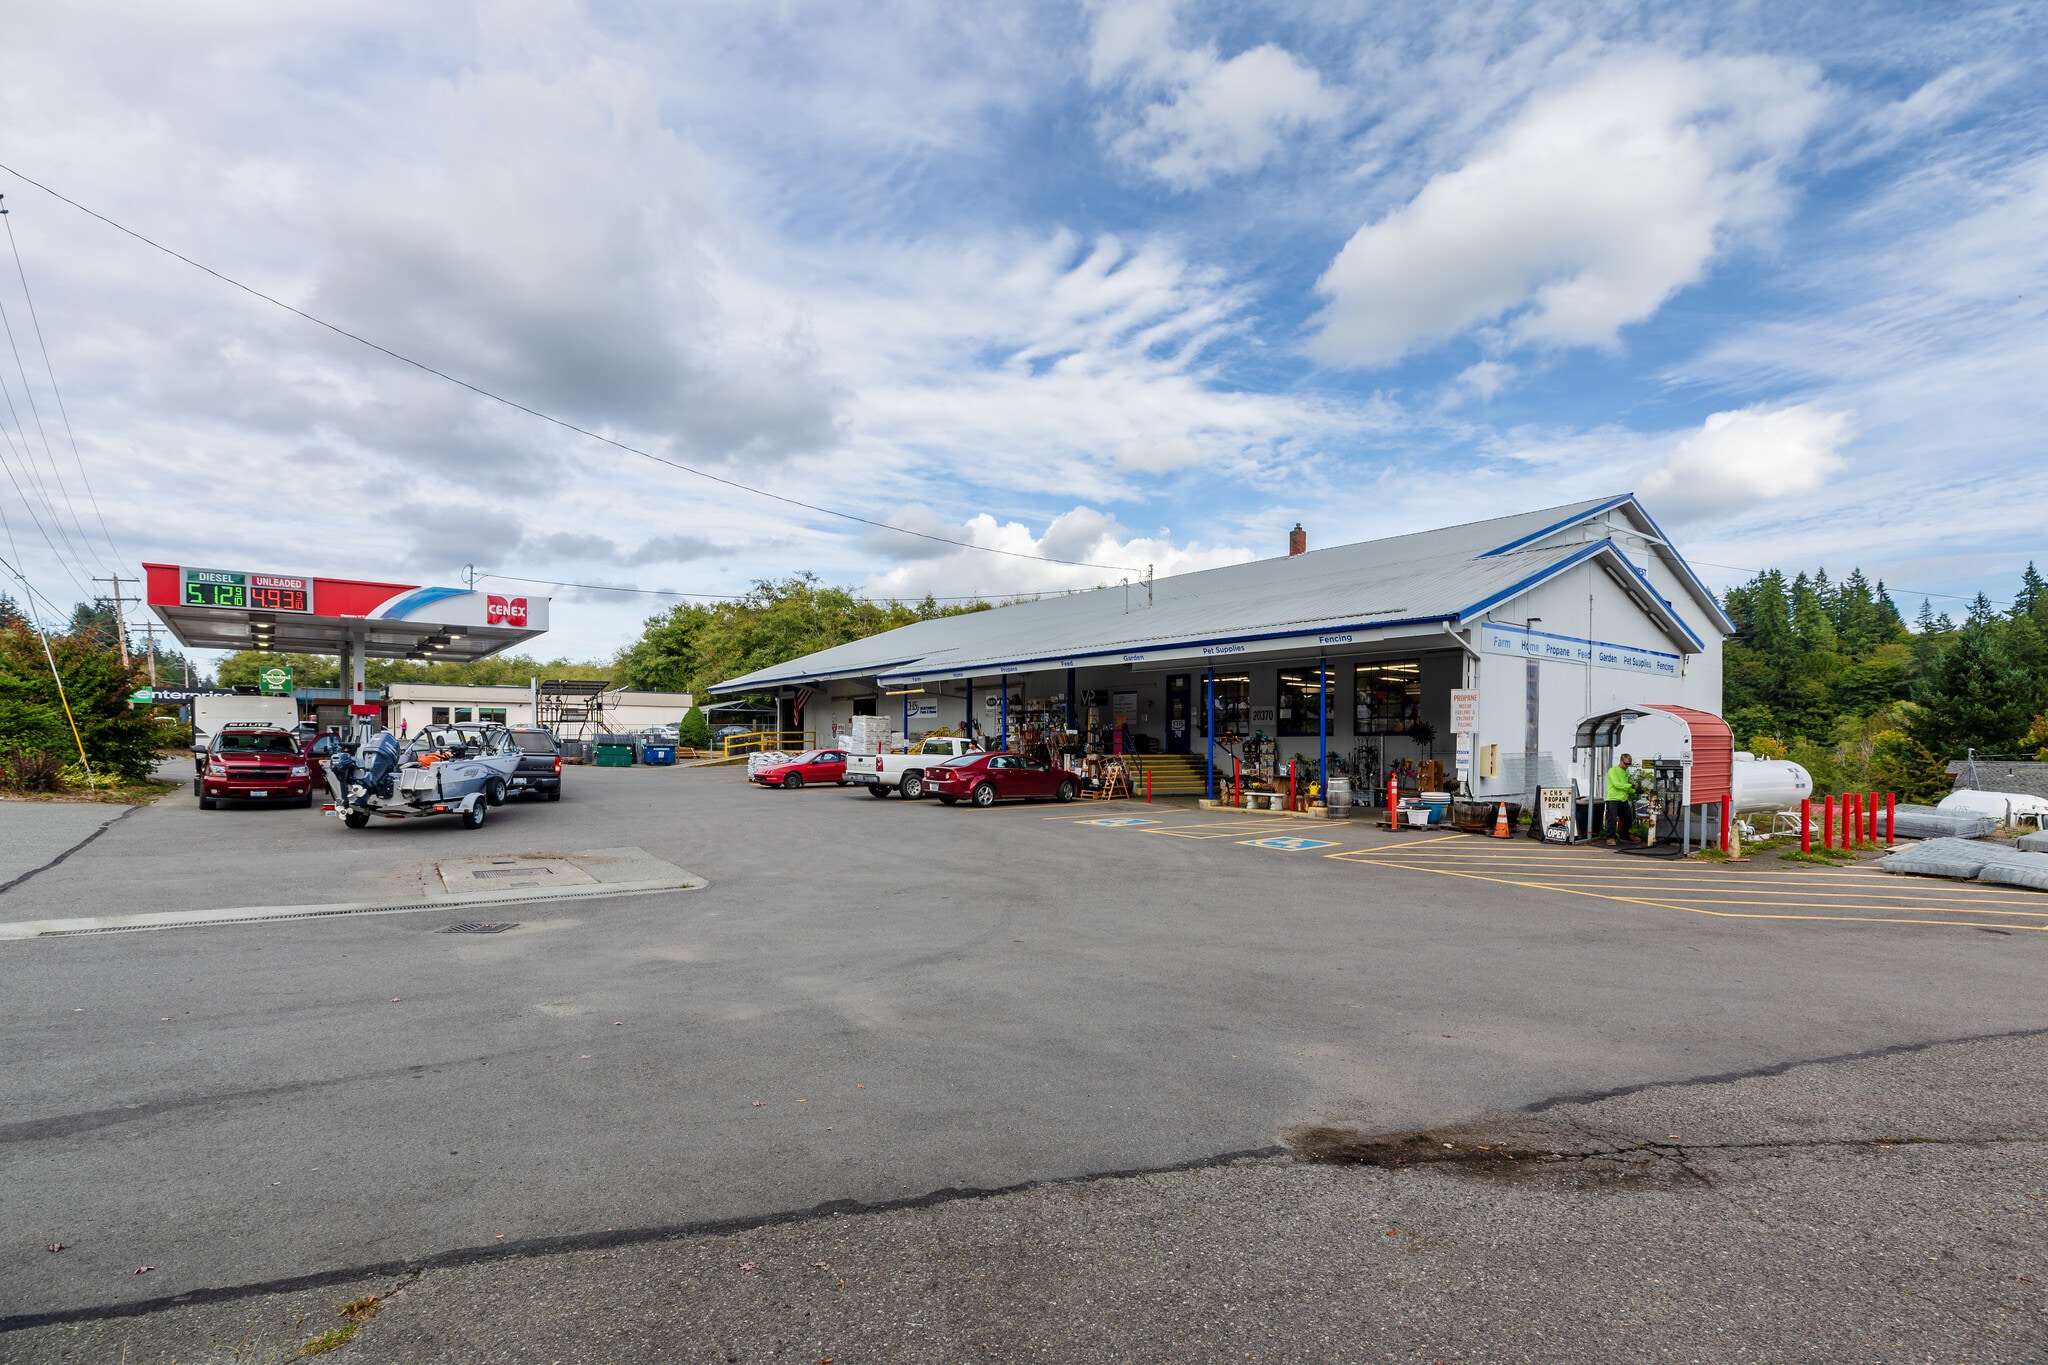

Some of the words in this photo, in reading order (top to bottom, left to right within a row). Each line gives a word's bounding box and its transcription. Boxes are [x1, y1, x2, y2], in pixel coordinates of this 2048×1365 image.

[199, 572, 234, 583] DIESEL
[256, 577, 302, 588] UNLEADED
[188, 583, 234, 605] 5.12
[252, 588, 295, 609] 4.93
[489, 604, 526, 617] CENEX
[1123, 654, 1145, 663] Garden
[1203, 646, 1215, 655] Pet
[1216, 644, 1245, 654] Supplies
[1319, 634, 1353, 644] Fencing
[1493, 636, 1511, 649] Farm
[1521, 640, 1540, 652] Home
[1546, 644, 1571, 656] Propane
[1577, 648, 1592, 660] Feed
[1599, 652, 1618, 663] Garden
[1623, 655, 1632, 666] Pet
[1632, 657, 1652, 669] Supplies
[1656, 660, 1674, 673] Fencing
[1453, 694, 1478, 702] PROPANE
[1252, 710, 1274, 721] 20370
[1547, 829, 1567, 840] OPEN
